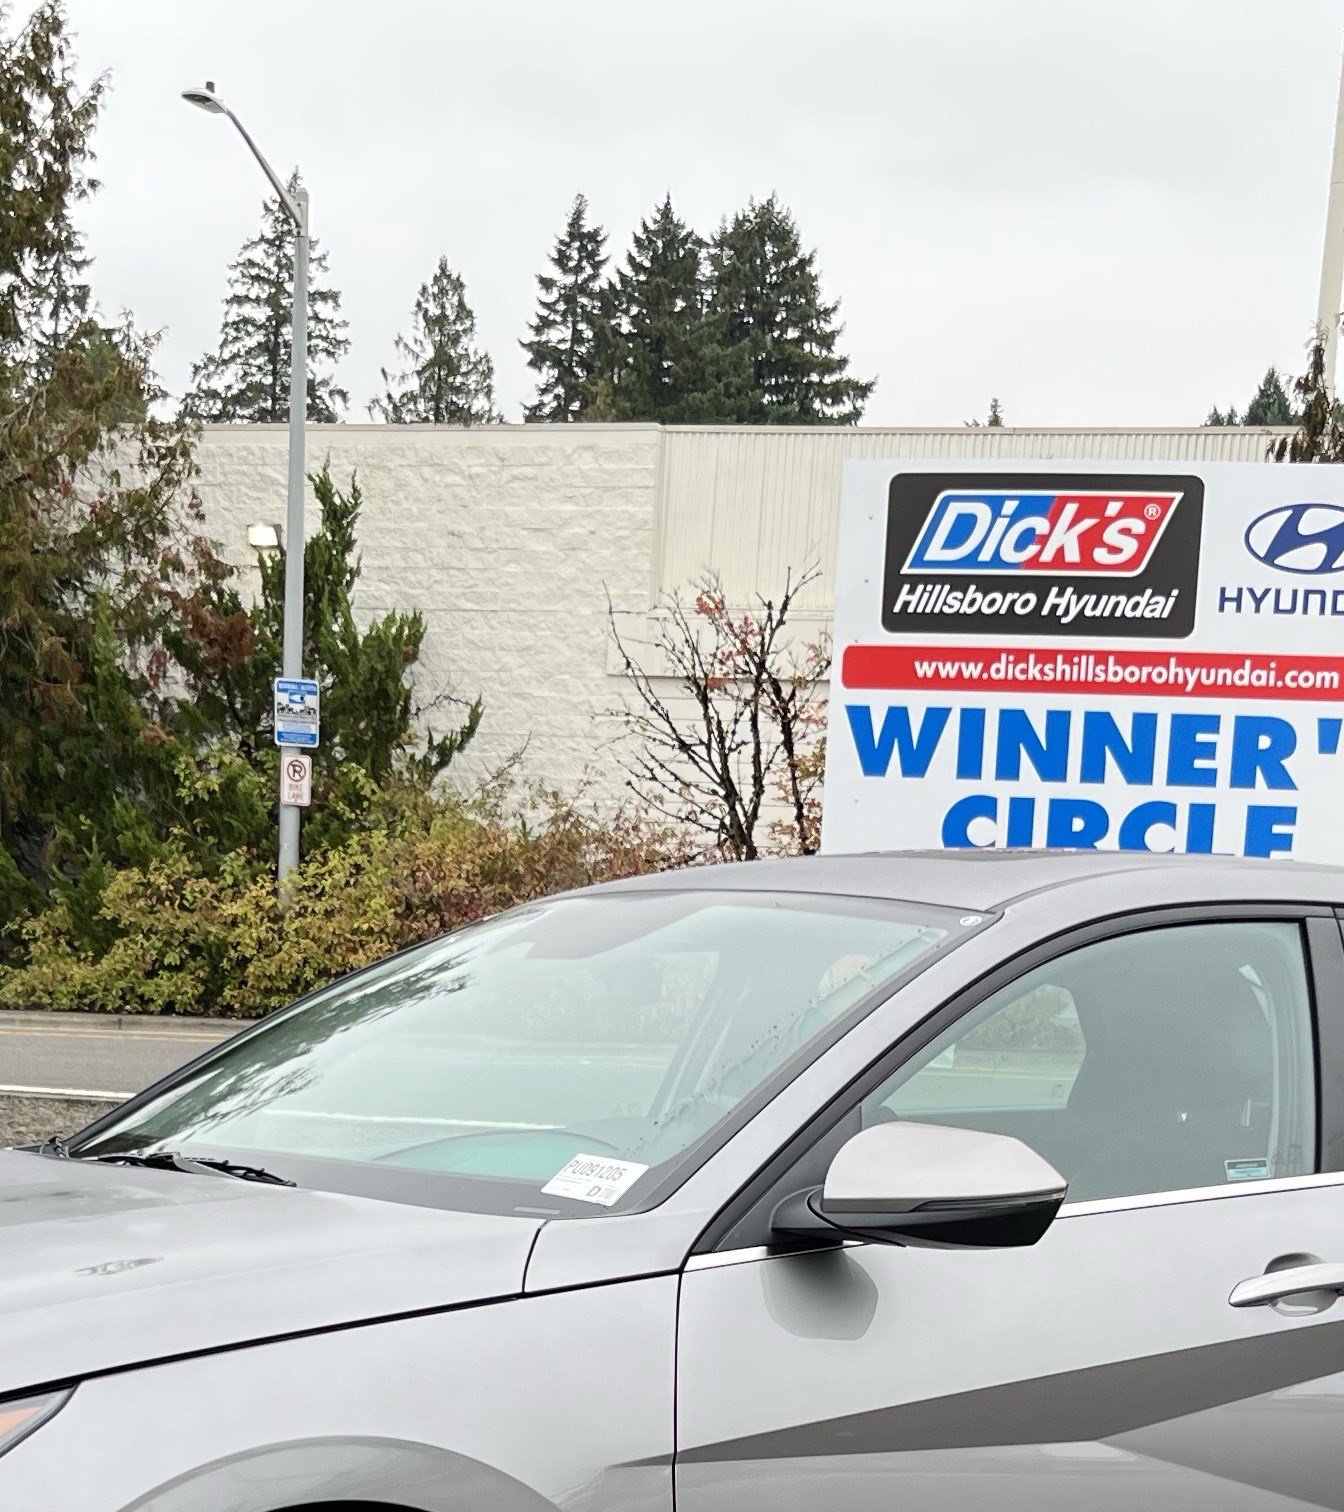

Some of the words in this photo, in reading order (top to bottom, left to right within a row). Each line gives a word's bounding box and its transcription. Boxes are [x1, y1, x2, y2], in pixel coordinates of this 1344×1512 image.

[922, 498, 1147, 567] Dick's
[893, 584, 1036, 616] Hillsboro
[1041, 587, 1179, 625] Hyundai
[914, 655, 1340, 691] www.dickshillsborohyundai.com
